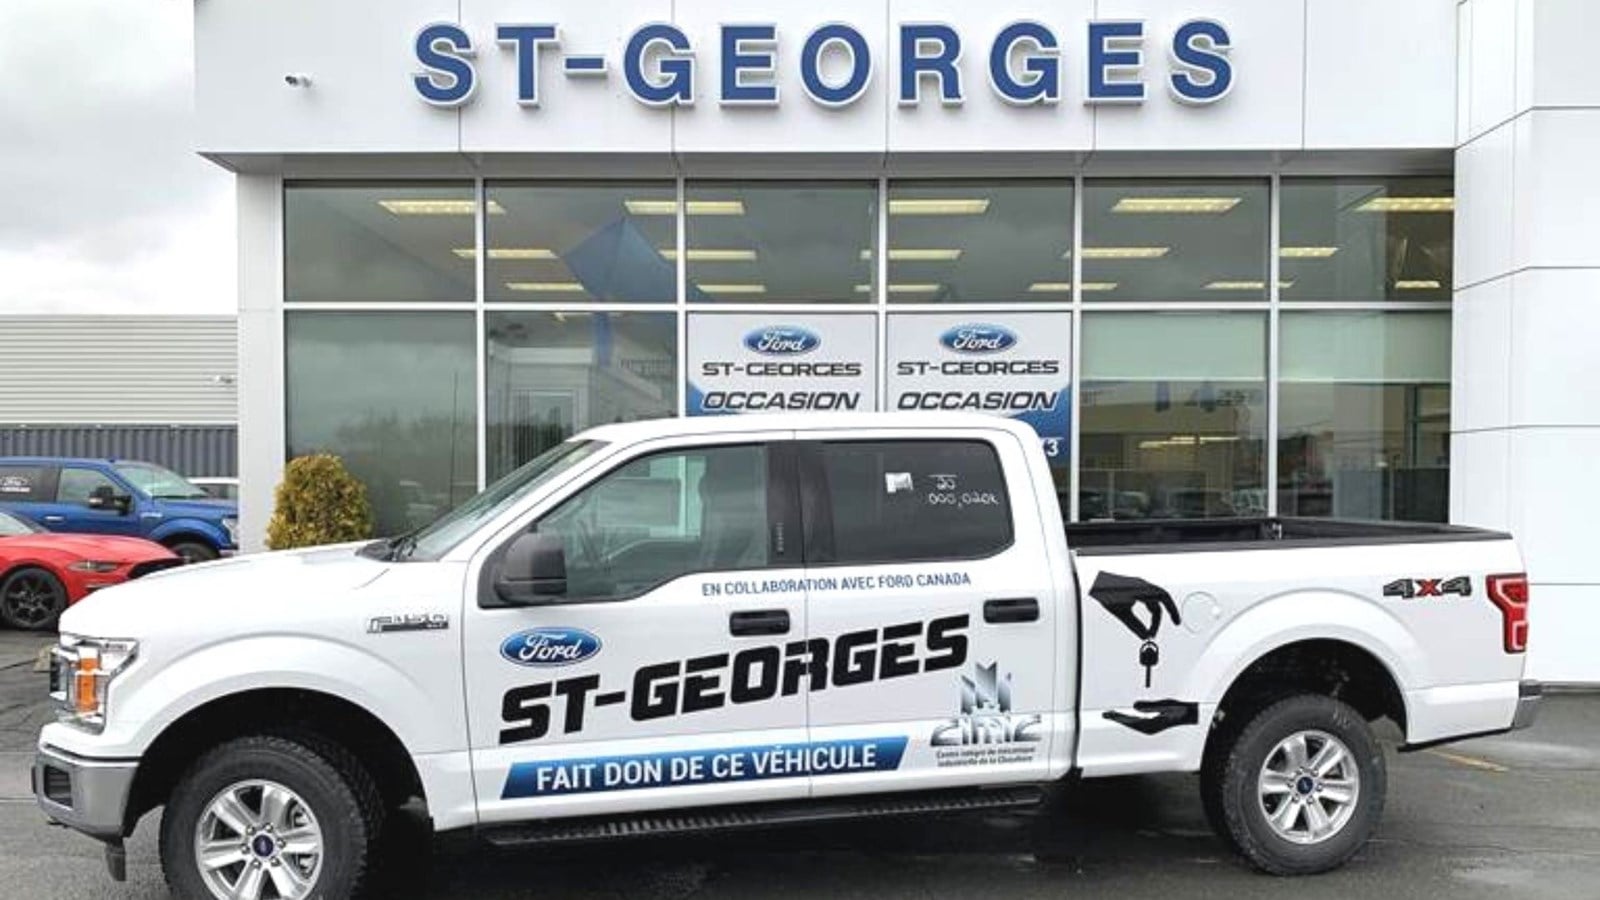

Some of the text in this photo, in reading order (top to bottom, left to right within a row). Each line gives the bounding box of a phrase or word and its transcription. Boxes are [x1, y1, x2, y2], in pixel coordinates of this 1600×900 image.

[412, 20, 1234, 107] ST-GEORGES
[702, 361, 862, 377] ST-GEORGES
[896, 359, 1060, 376] ST-GEORGES
[702, 391, 861, 411] OCCASION
[897, 391, 1057, 411] OCCASION
[702, 572, 972, 597] EN COLLABORATION AVEC FORD CANADA
[518, 632, 583, 661] Ford
[499, 613, 970, 746] ST-GEORGES
[536, 744, 877, 791] FAIT DON DE CE VÉHICULE
